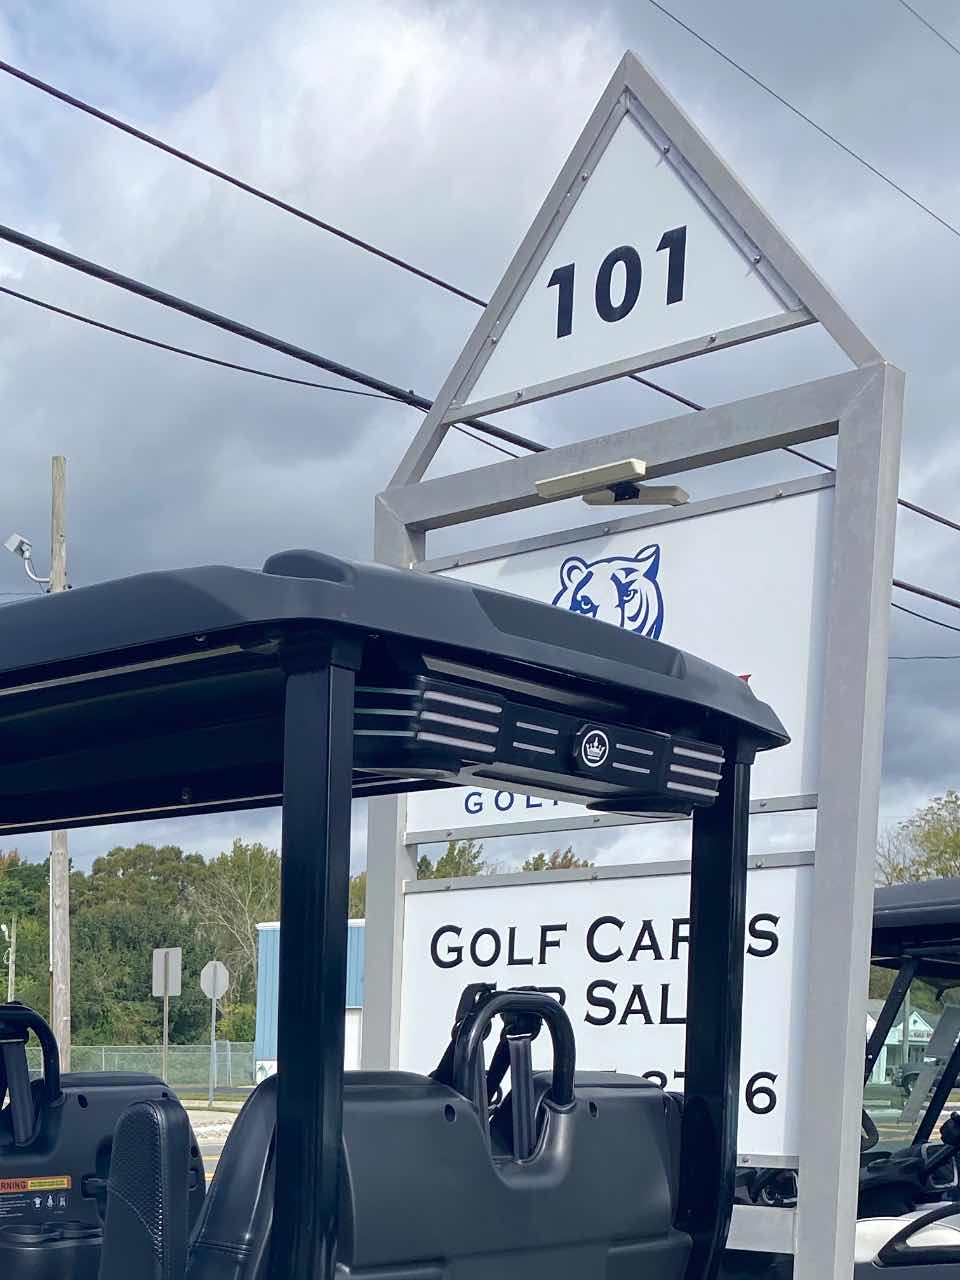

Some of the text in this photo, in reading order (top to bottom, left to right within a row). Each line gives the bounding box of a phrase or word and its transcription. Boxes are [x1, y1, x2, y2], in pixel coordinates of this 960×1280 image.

[546, 225, 688, 339] 101
[464, 790, 559, 814] GOL
[430, 913, 781, 969] GOLF CAS
[584, 979, 688, 1026] SAL
